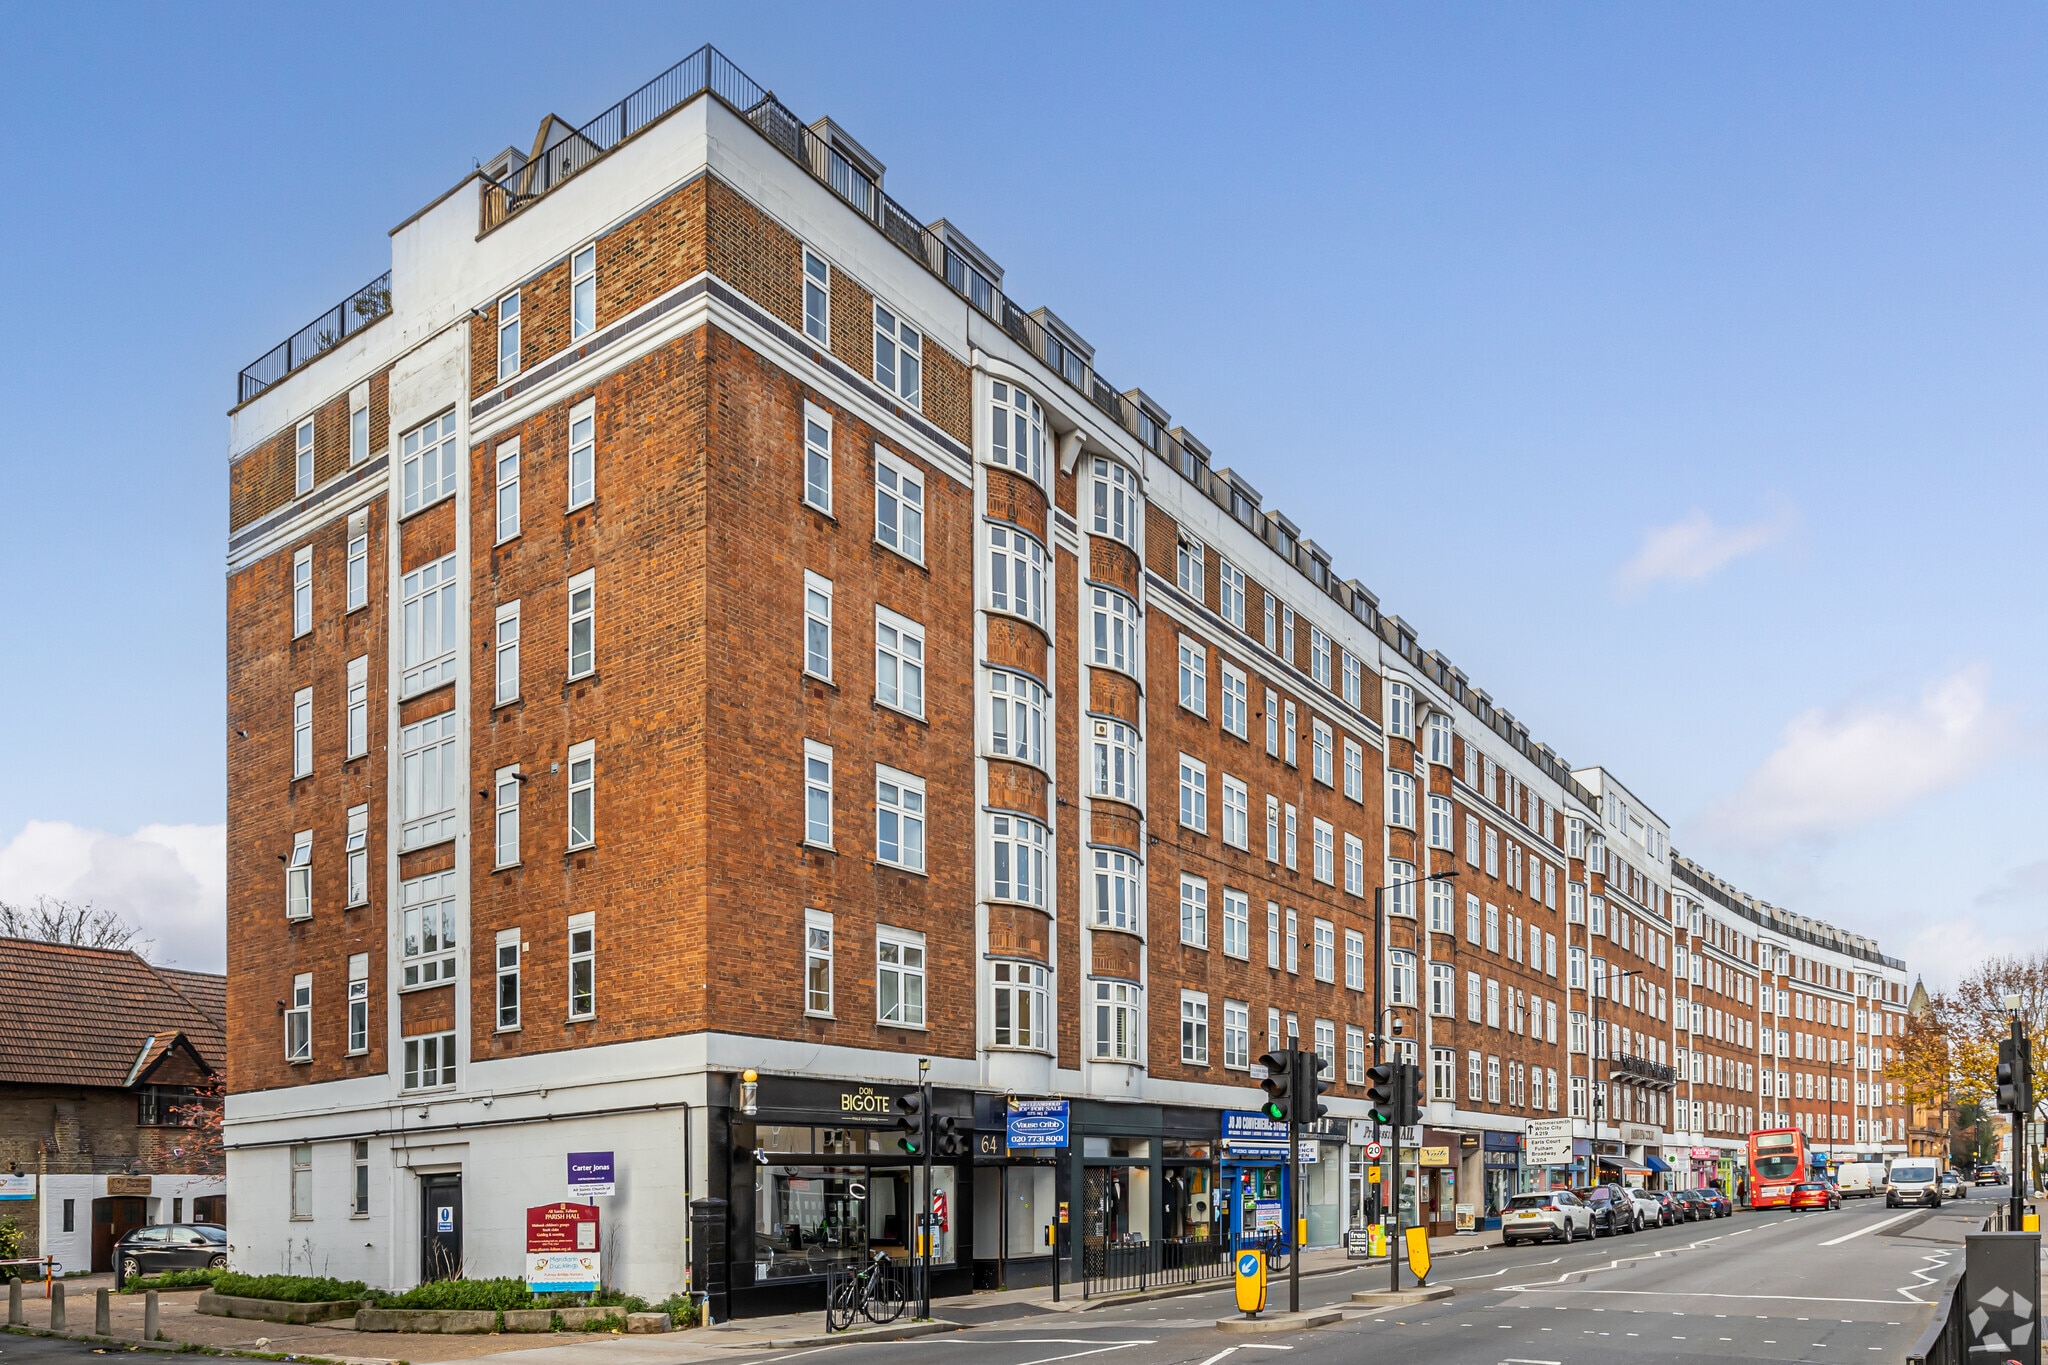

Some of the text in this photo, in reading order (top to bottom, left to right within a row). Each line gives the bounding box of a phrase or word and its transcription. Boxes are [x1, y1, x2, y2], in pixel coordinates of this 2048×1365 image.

[859, 1087, 873, 1095] DON
[841, 1094, 890, 1112] BIGOTE
[981, 1134, 997, 1154] 64
